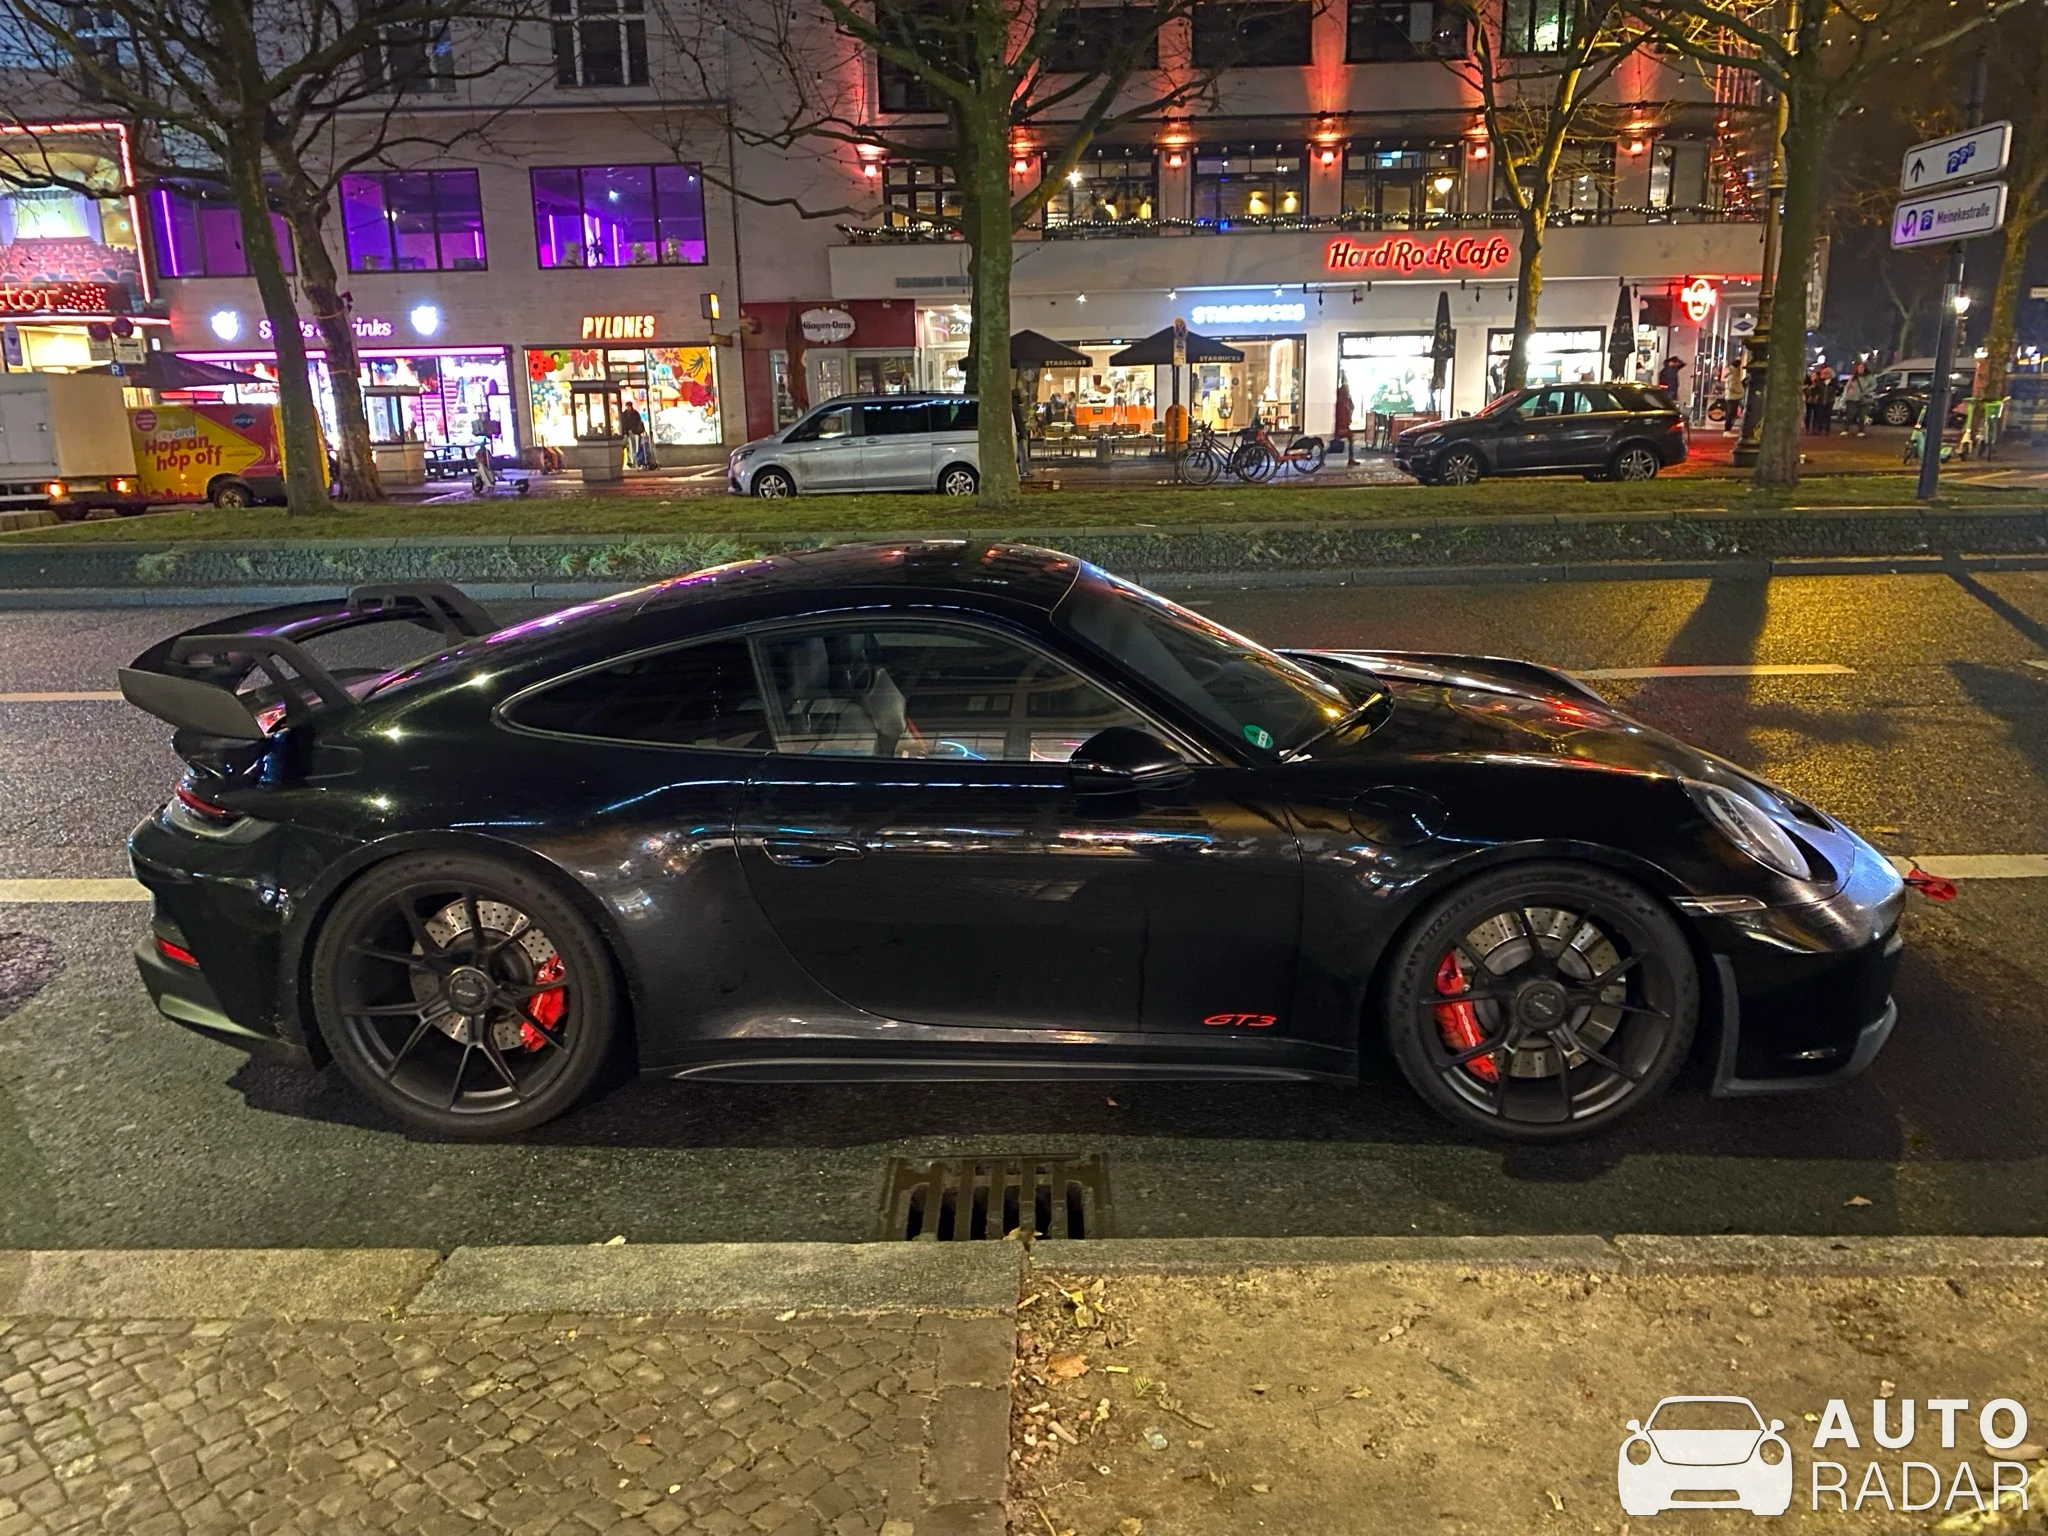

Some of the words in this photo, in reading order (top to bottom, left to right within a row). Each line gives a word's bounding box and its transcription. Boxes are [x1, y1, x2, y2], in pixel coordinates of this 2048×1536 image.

[1937, 203, 1990, 224] Meinekestraße
[1331, 242, 1392, 268] Hard
[1395, 241, 1451, 271] Rock
[1455, 239, 1509, 270] Cafe
[1192, 304, 1305, 323] STARBUCKS
[582, 316, 655, 339] PYLONES
[144, 439, 181, 456] Hop
[186, 436, 209, 450] on
[156, 453, 190, 471] hop
[195, 445, 222, 466] off
[1203, 1013, 1277, 1027] GT3
